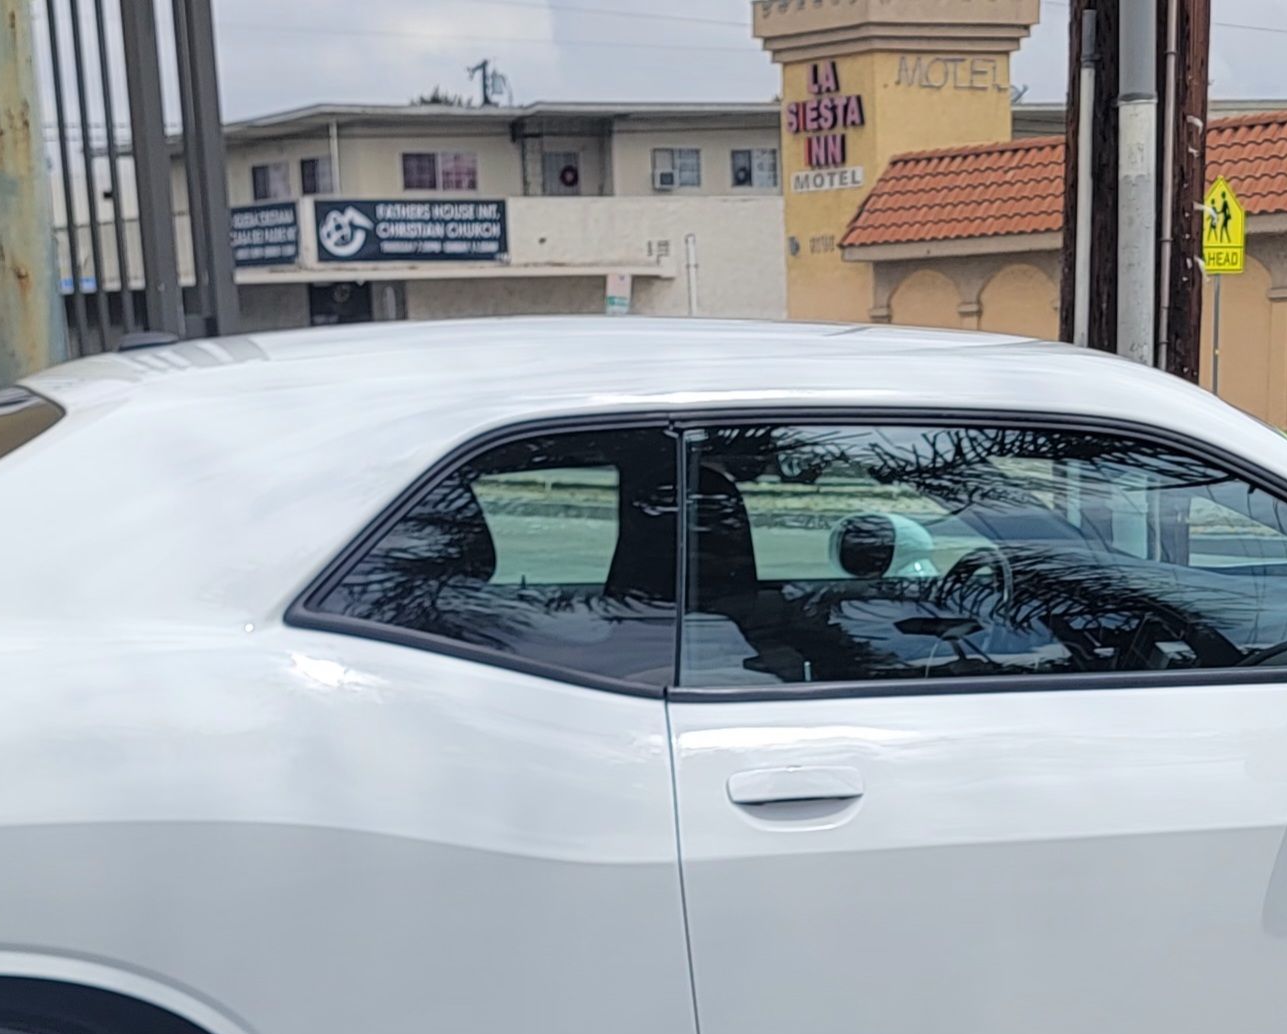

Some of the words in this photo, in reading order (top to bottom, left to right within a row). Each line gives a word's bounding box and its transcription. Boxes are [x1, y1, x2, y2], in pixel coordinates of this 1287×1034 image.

[808, 60, 839, 94] LA
[895, 56, 1008, 92] MOTEL
[786, 95, 864, 133] SIESTA
[805, 134, 845, 167] INN
[793, 170, 861, 190] MOTEL
[376, 222, 444, 239] CHRISTIAN
[445, 222, 501, 239] CHURCH
[1206, 251, 1239, 267] HEAD
